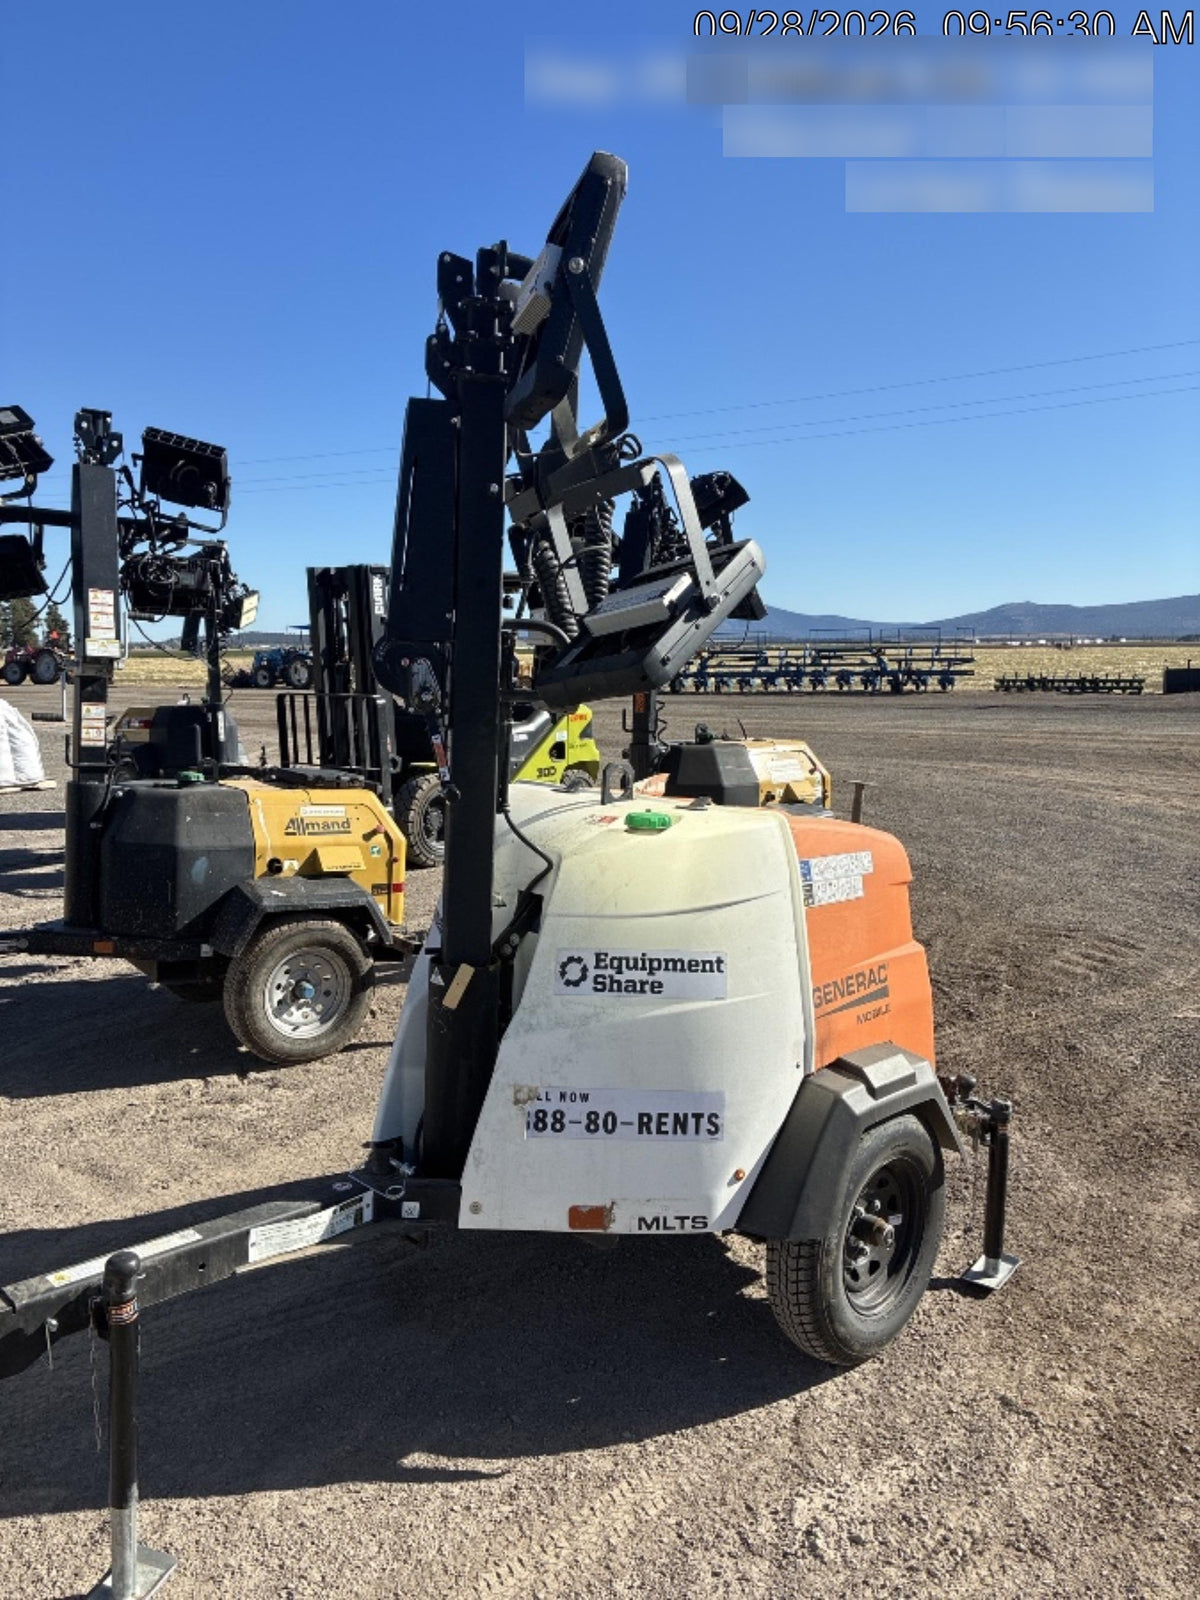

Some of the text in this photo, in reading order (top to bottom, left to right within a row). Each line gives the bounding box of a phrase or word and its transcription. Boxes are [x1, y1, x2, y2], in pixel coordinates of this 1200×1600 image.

[284, 817, 352, 836] Allmand
[593, 952, 725, 976] Equipment
[592, 974, 664, 994] Share
[812, 963, 888, 1009] GENERAC
[559, 1091, 590, 1103] NOW
[526, 1109, 720, 1136] 88-80-RENTS
[637, 1215, 709, 1231] MLTS
